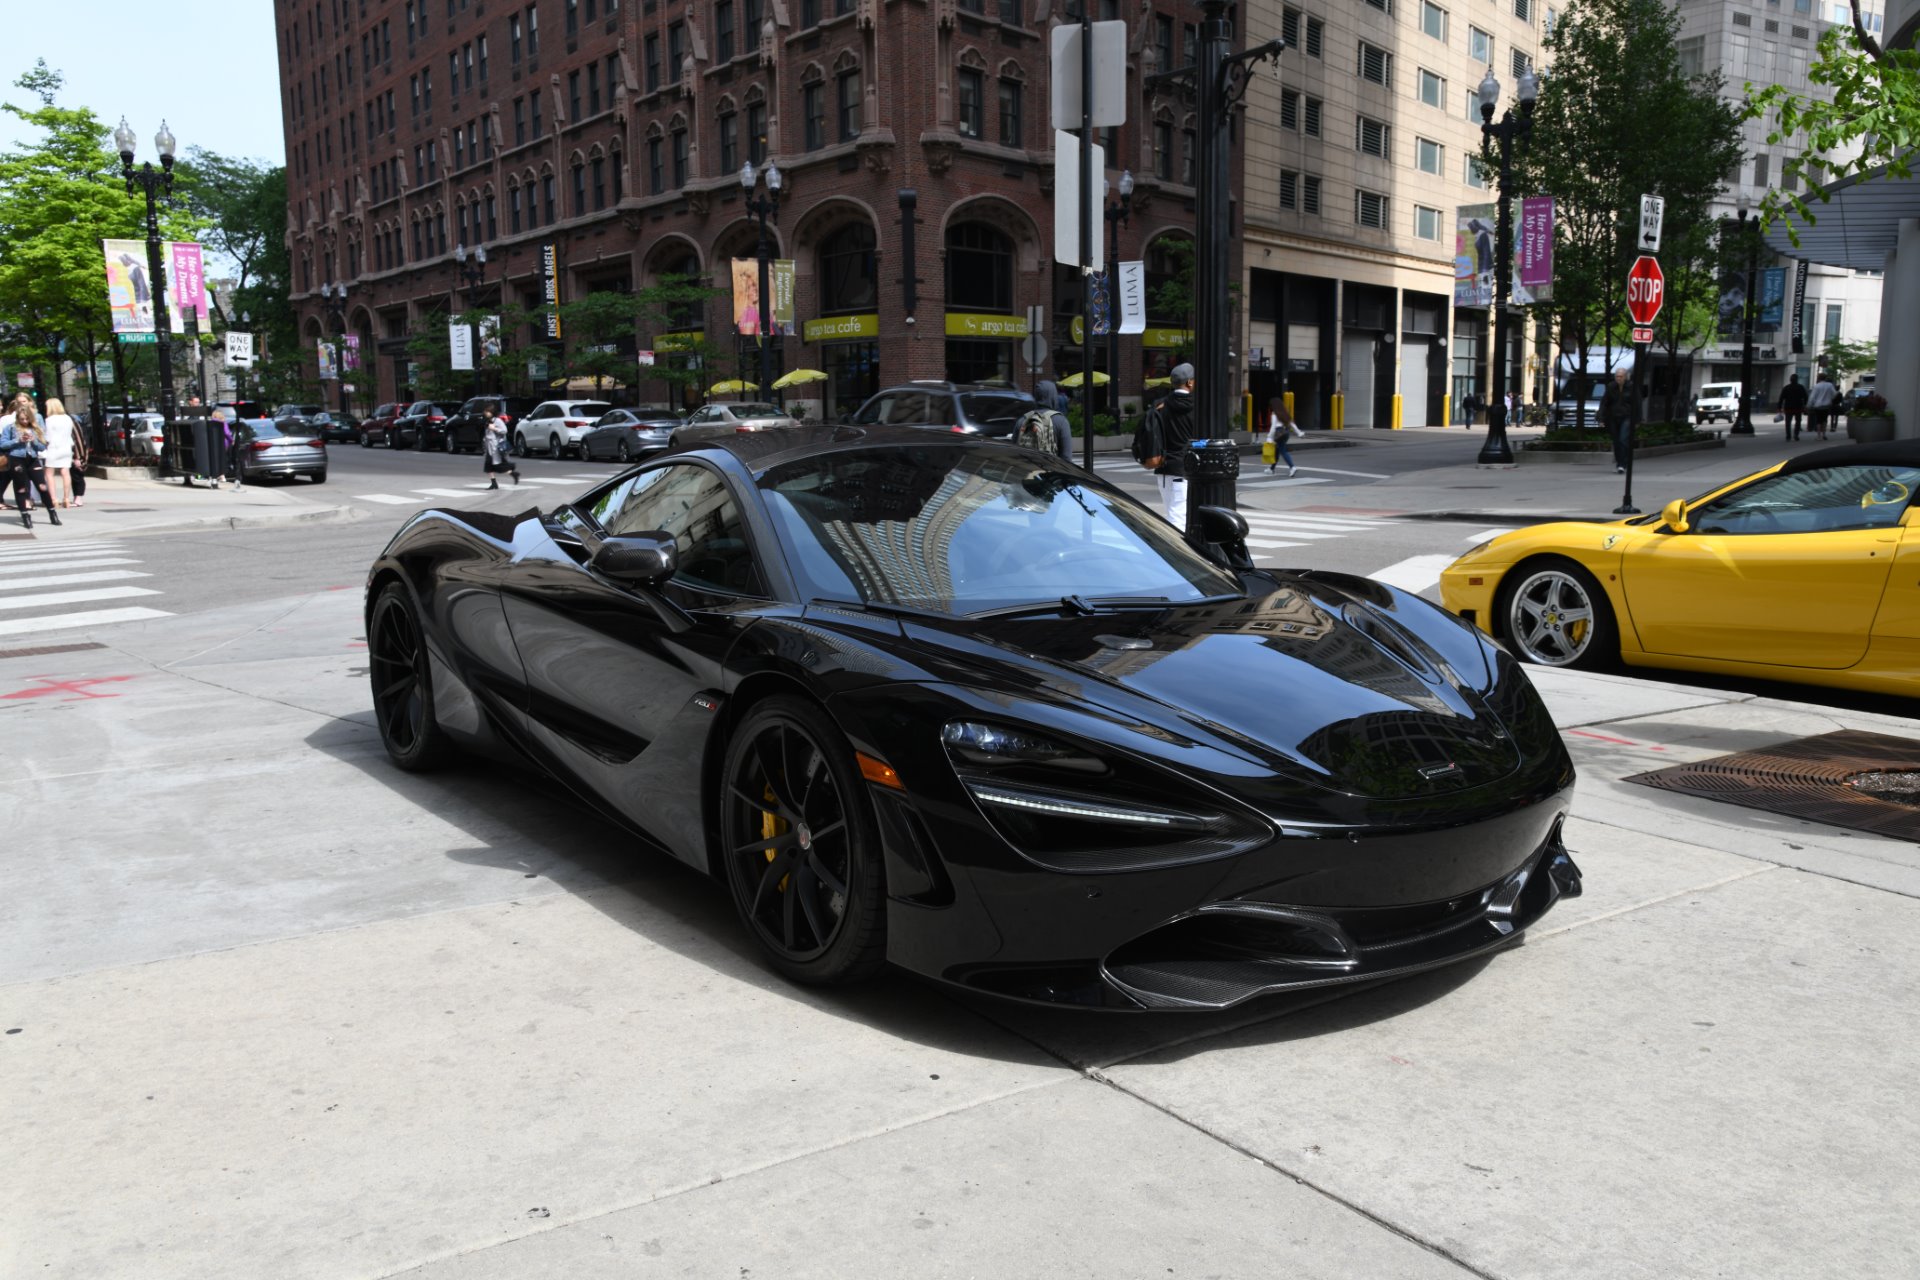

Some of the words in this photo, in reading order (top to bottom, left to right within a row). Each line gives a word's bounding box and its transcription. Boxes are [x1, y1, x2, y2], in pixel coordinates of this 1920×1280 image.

[1643, 200, 1660, 214] ONE
[1524, 214, 1535, 230] My
[1536, 213, 1547, 232] Her
[1643, 215, 1660, 229] WAY
[1525, 232, 1535, 269] Dreams
[175, 255, 187, 270] My
[187, 255, 197, 273] Her
[543, 245, 554, 276] BAGELS
[178, 271, 189, 304] Dreams
[784, 272, 792, 305] Everyday
[1125, 266, 1139, 316] LUMA
[1629, 277, 1661, 303] STOP
[1794, 263, 1805, 314] NORDSTROM
[824, 323, 836, 334] tea
[838, 316, 862, 333] café
[981, 321, 1002, 335] argo
[1004, 321, 1015, 332] tea
[1792, 317, 1801, 338] rack
[125, 334, 146, 342] RUSH
[230, 335, 248, 344] ONE
[230, 345, 249, 353] WAY
